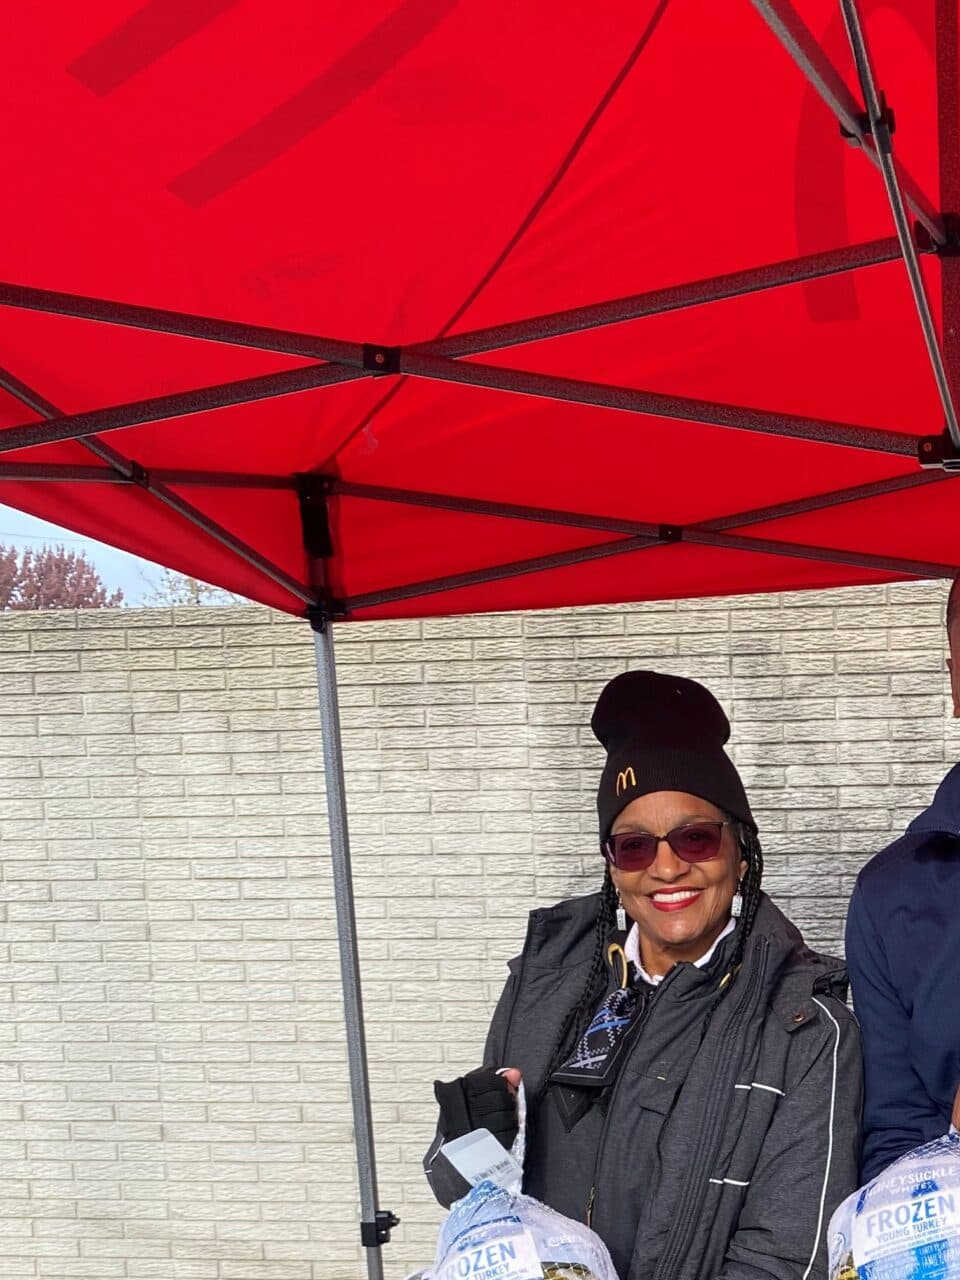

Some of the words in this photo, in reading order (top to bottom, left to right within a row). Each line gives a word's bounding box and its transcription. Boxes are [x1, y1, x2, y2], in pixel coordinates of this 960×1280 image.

[866, 1194, 955, 1238] FROZEN
[876, 1225, 910, 1244] YOUNG
[912, 1216, 947, 1234] TURKEY
